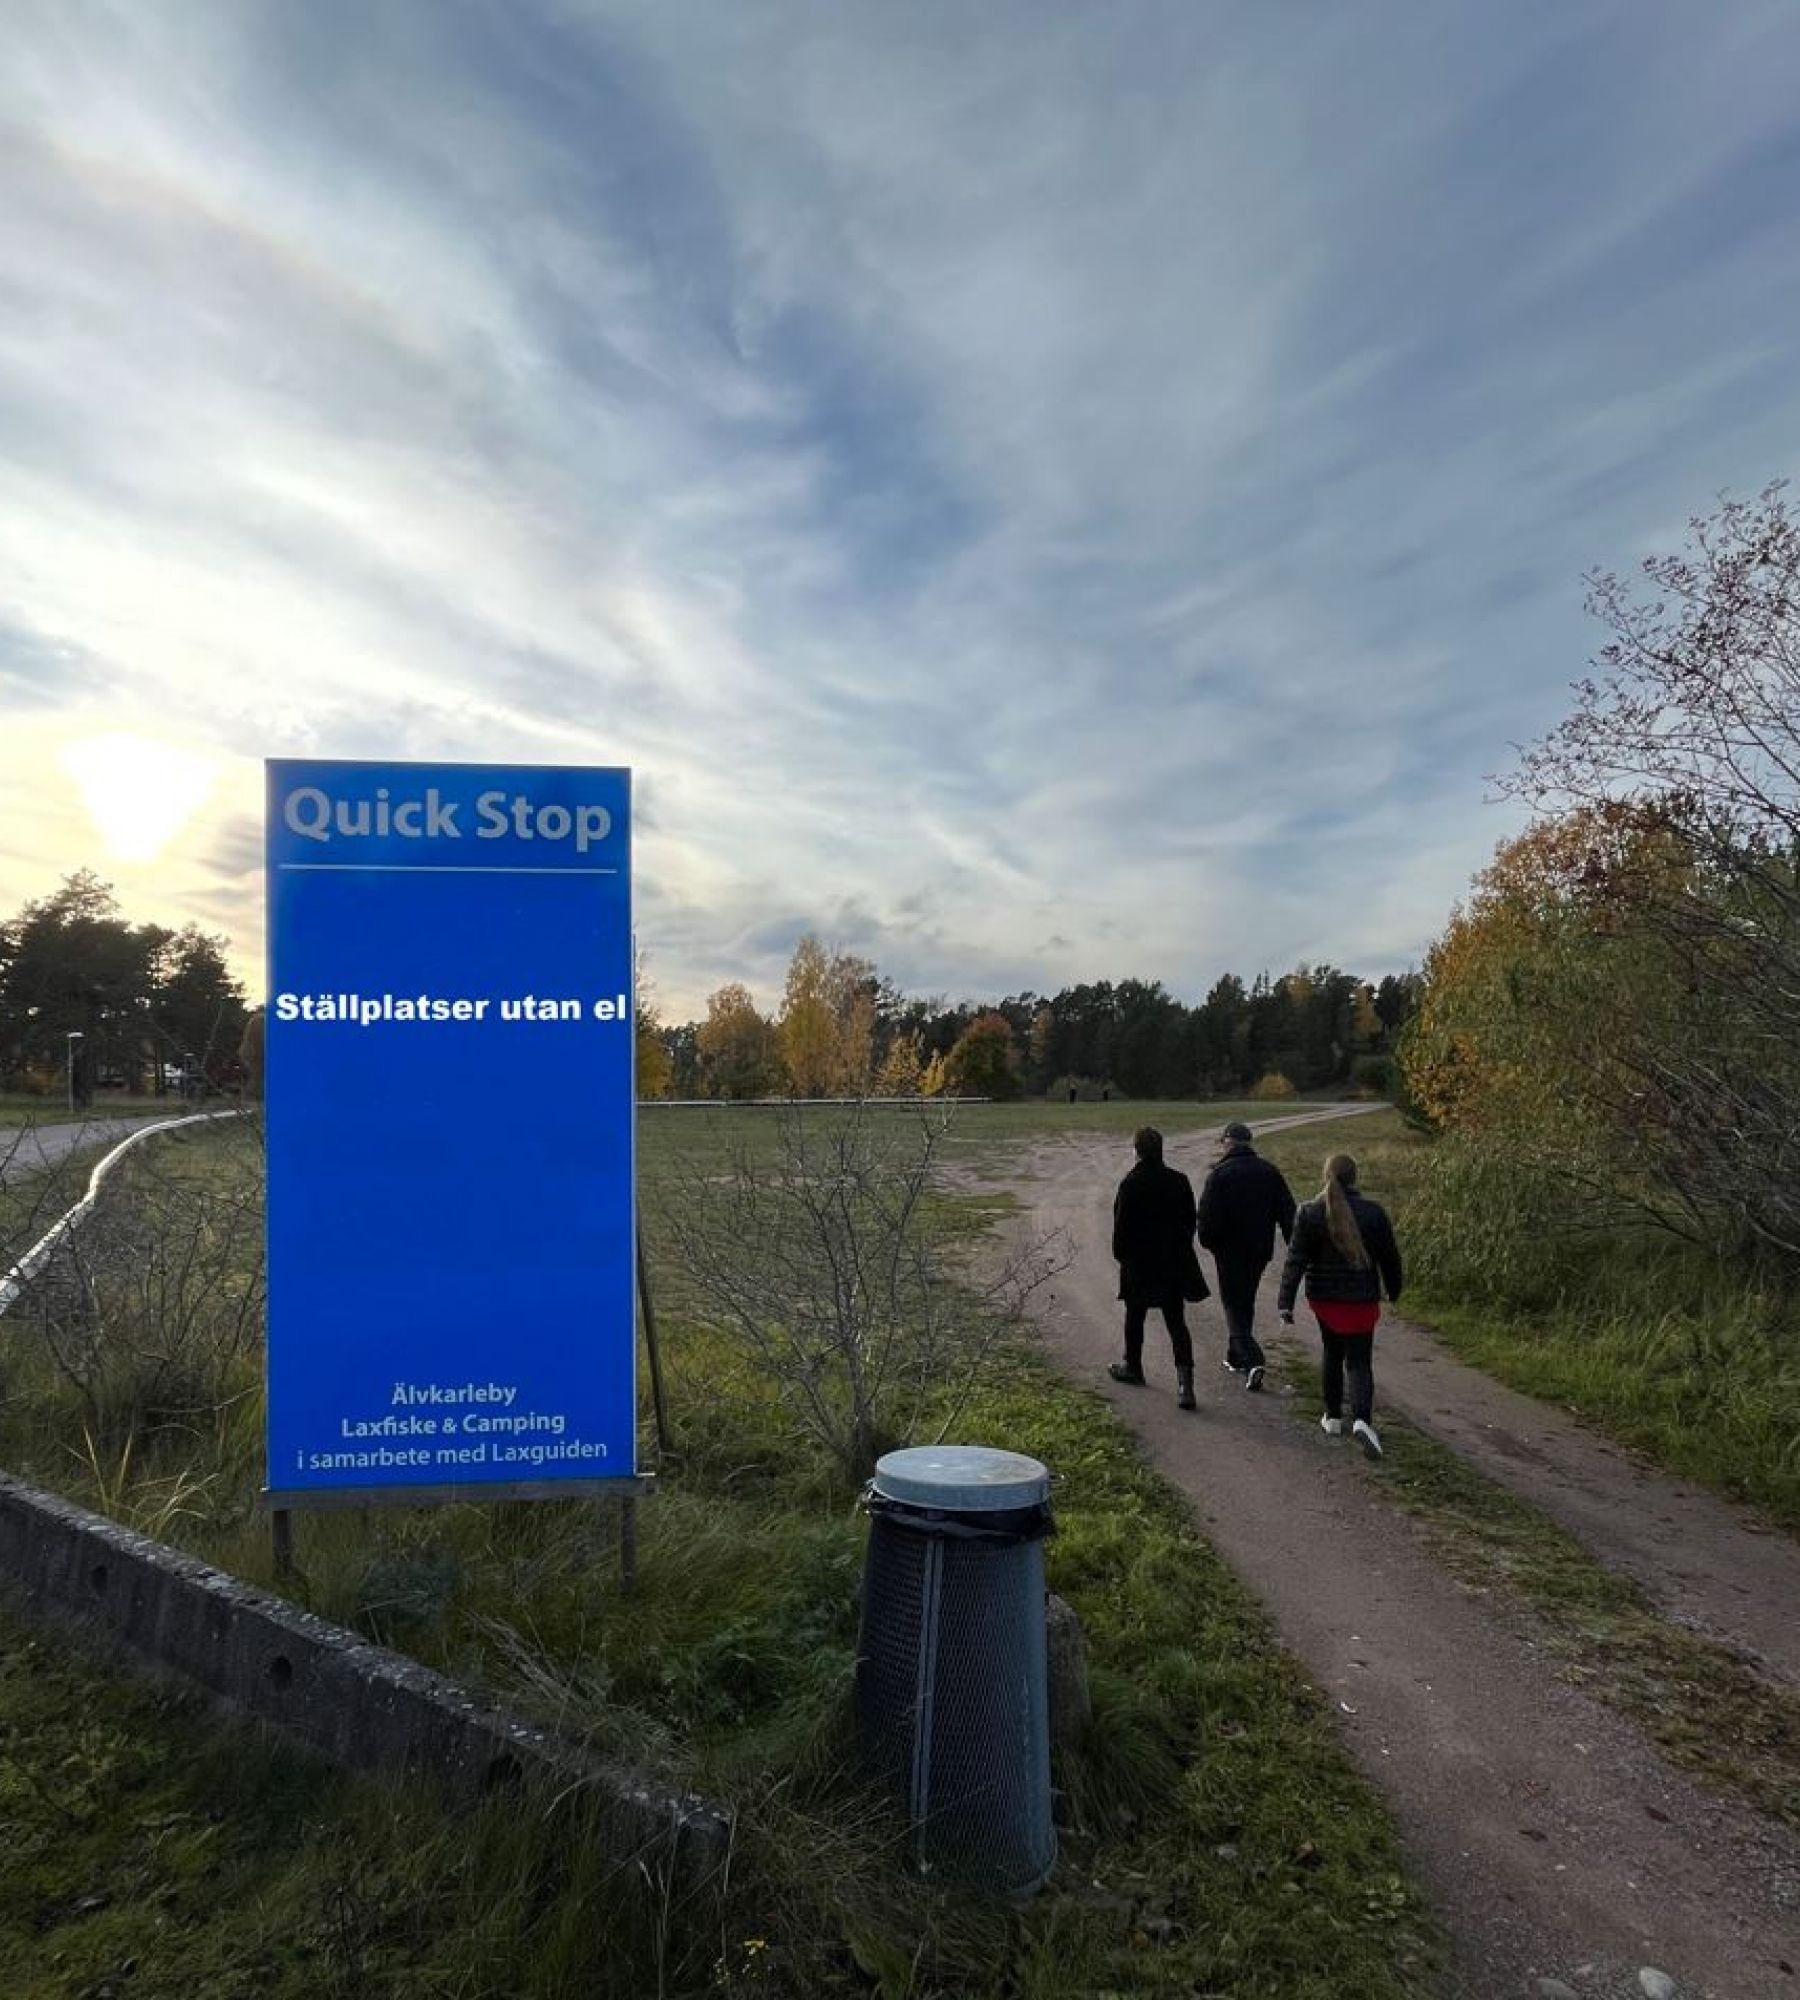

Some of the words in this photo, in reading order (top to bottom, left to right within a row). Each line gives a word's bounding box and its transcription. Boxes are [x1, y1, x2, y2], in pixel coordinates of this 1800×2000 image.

[284, 786, 461, 843] Quick
[475, 790, 612, 853] Stop
[390, 1382, 517, 1407] Älvkarleby
[340, 1416, 438, 1438] Laxfiske
[442, 1418, 457, 1435] &
[462, 1411, 566, 1436] Camping
[297, 1451, 304, 1470] i
[309, 1447, 432, 1470] samarbete
[436, 1443, 486, 1464] med
[492, 1439, 608, 1465] Laxguiden
